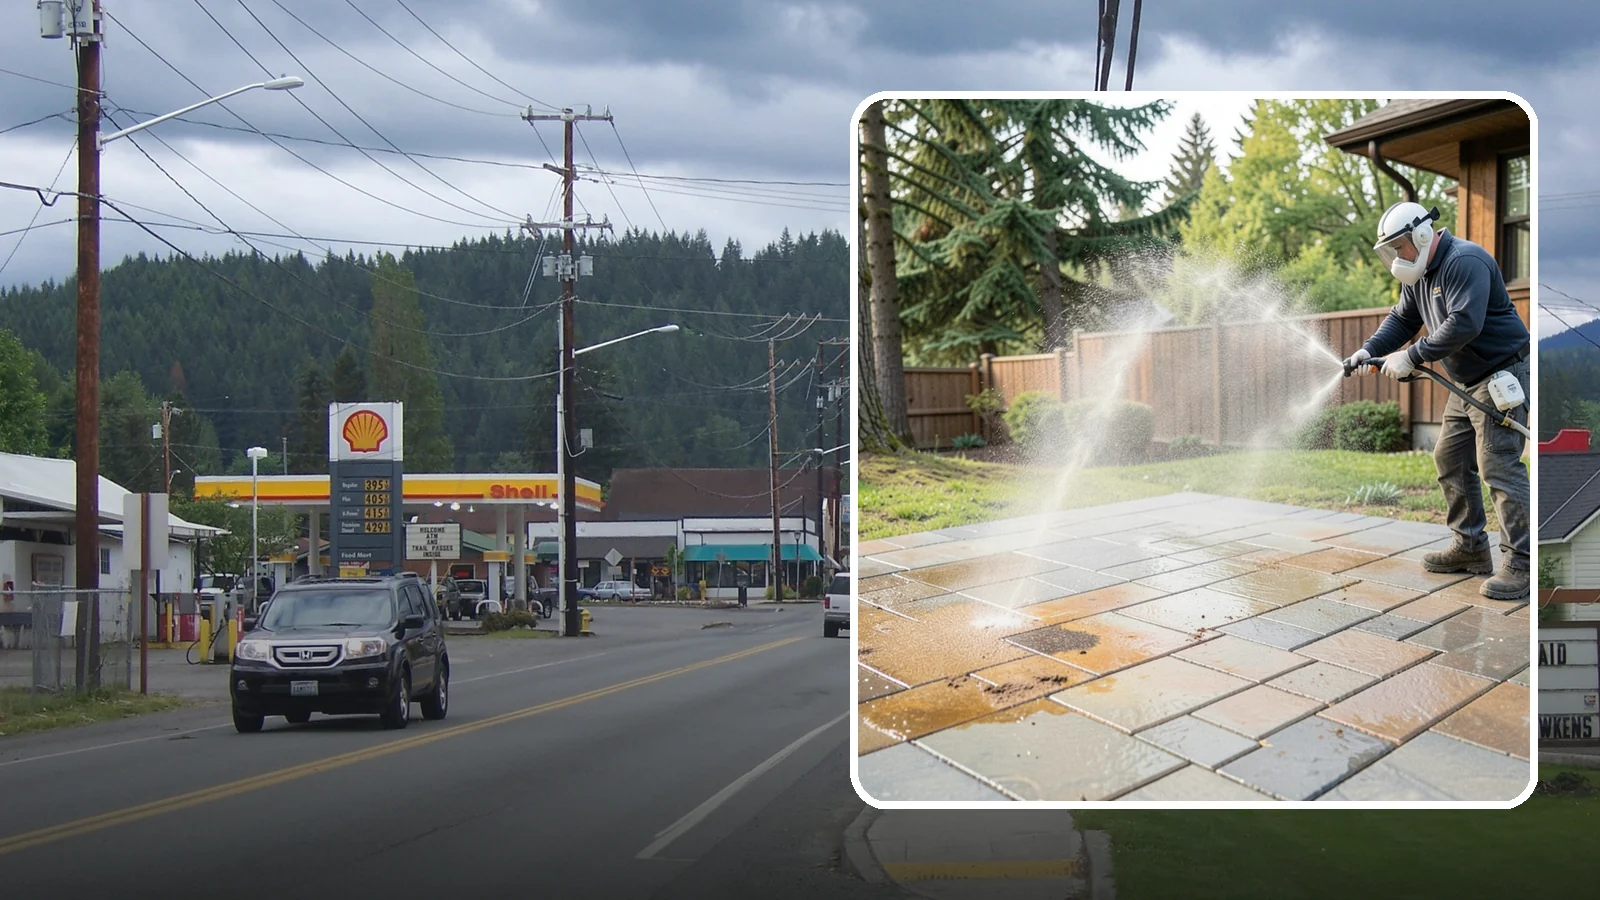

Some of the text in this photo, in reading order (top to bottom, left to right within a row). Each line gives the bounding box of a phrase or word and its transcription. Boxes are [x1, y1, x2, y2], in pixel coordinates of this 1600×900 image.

[365, 480, 384, 490] 395
[490, 484, 547, 499] Shell
[365, 494, 384, 504] 405
[365, 508, 384, 518] 415
[365, 522, 384, 532] 429
